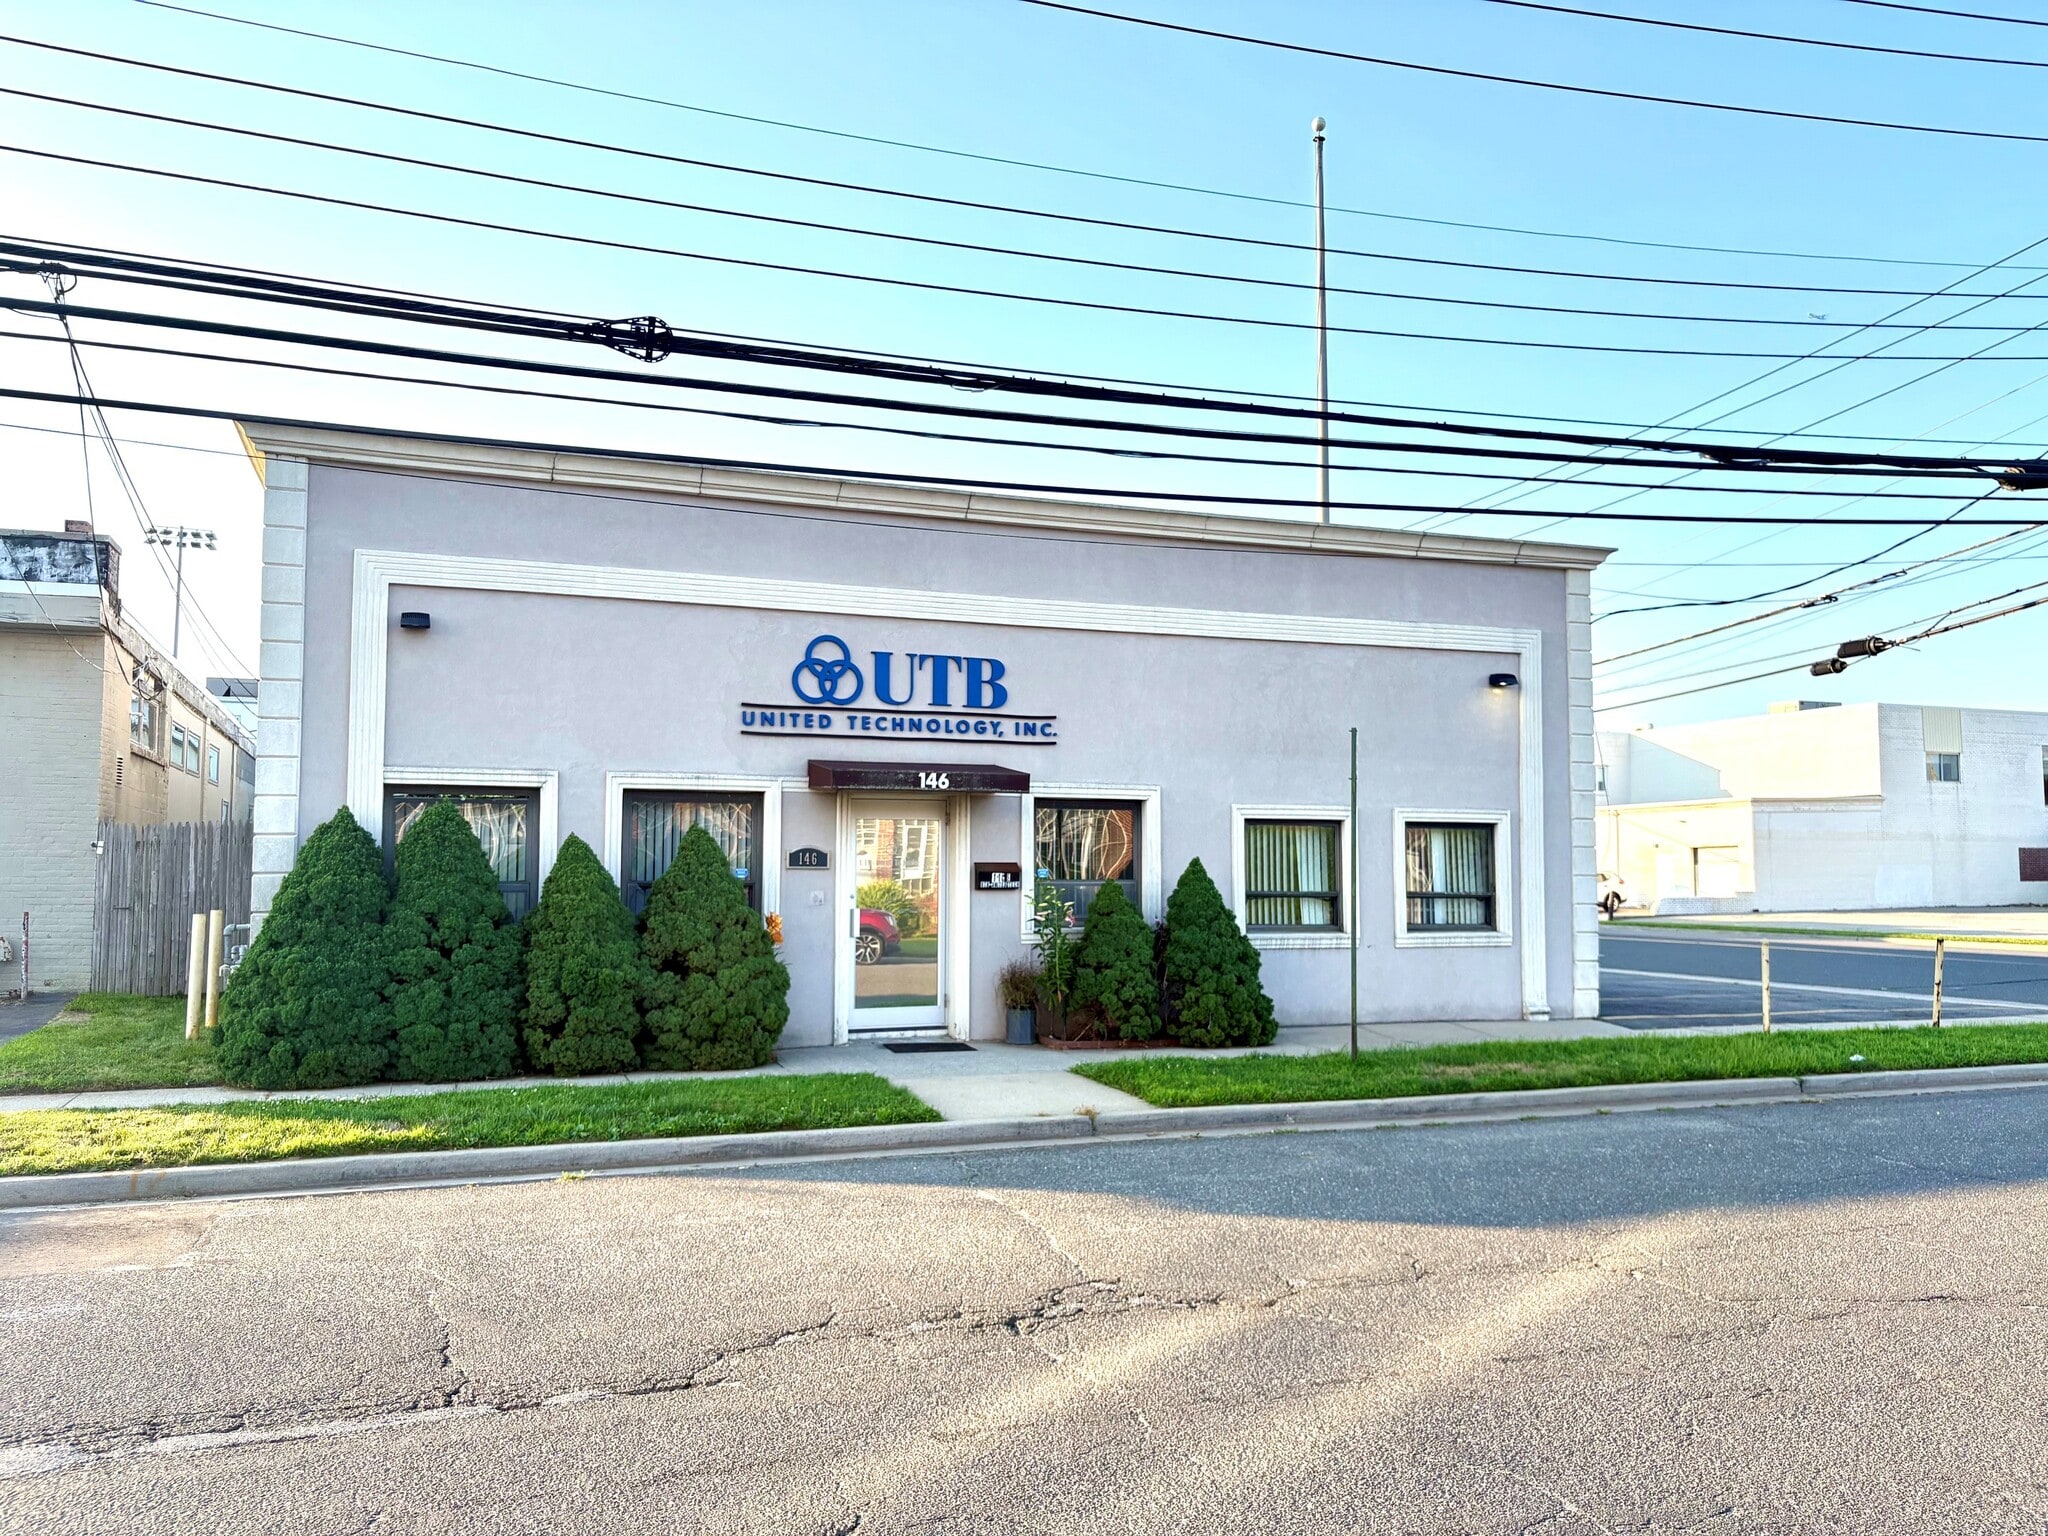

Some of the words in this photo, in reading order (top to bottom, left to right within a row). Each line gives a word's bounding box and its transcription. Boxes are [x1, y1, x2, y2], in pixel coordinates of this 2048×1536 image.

[871, 651, 1008, 708] UTB
[742, 711, 832, 729] UNITED
[847, 715, 1004, 738] TECHNOLOGY,
[1014, 722, 1057, 736] INC.
[918, 773, 950, 790] 146
[799, 852, 817, 865] 146
